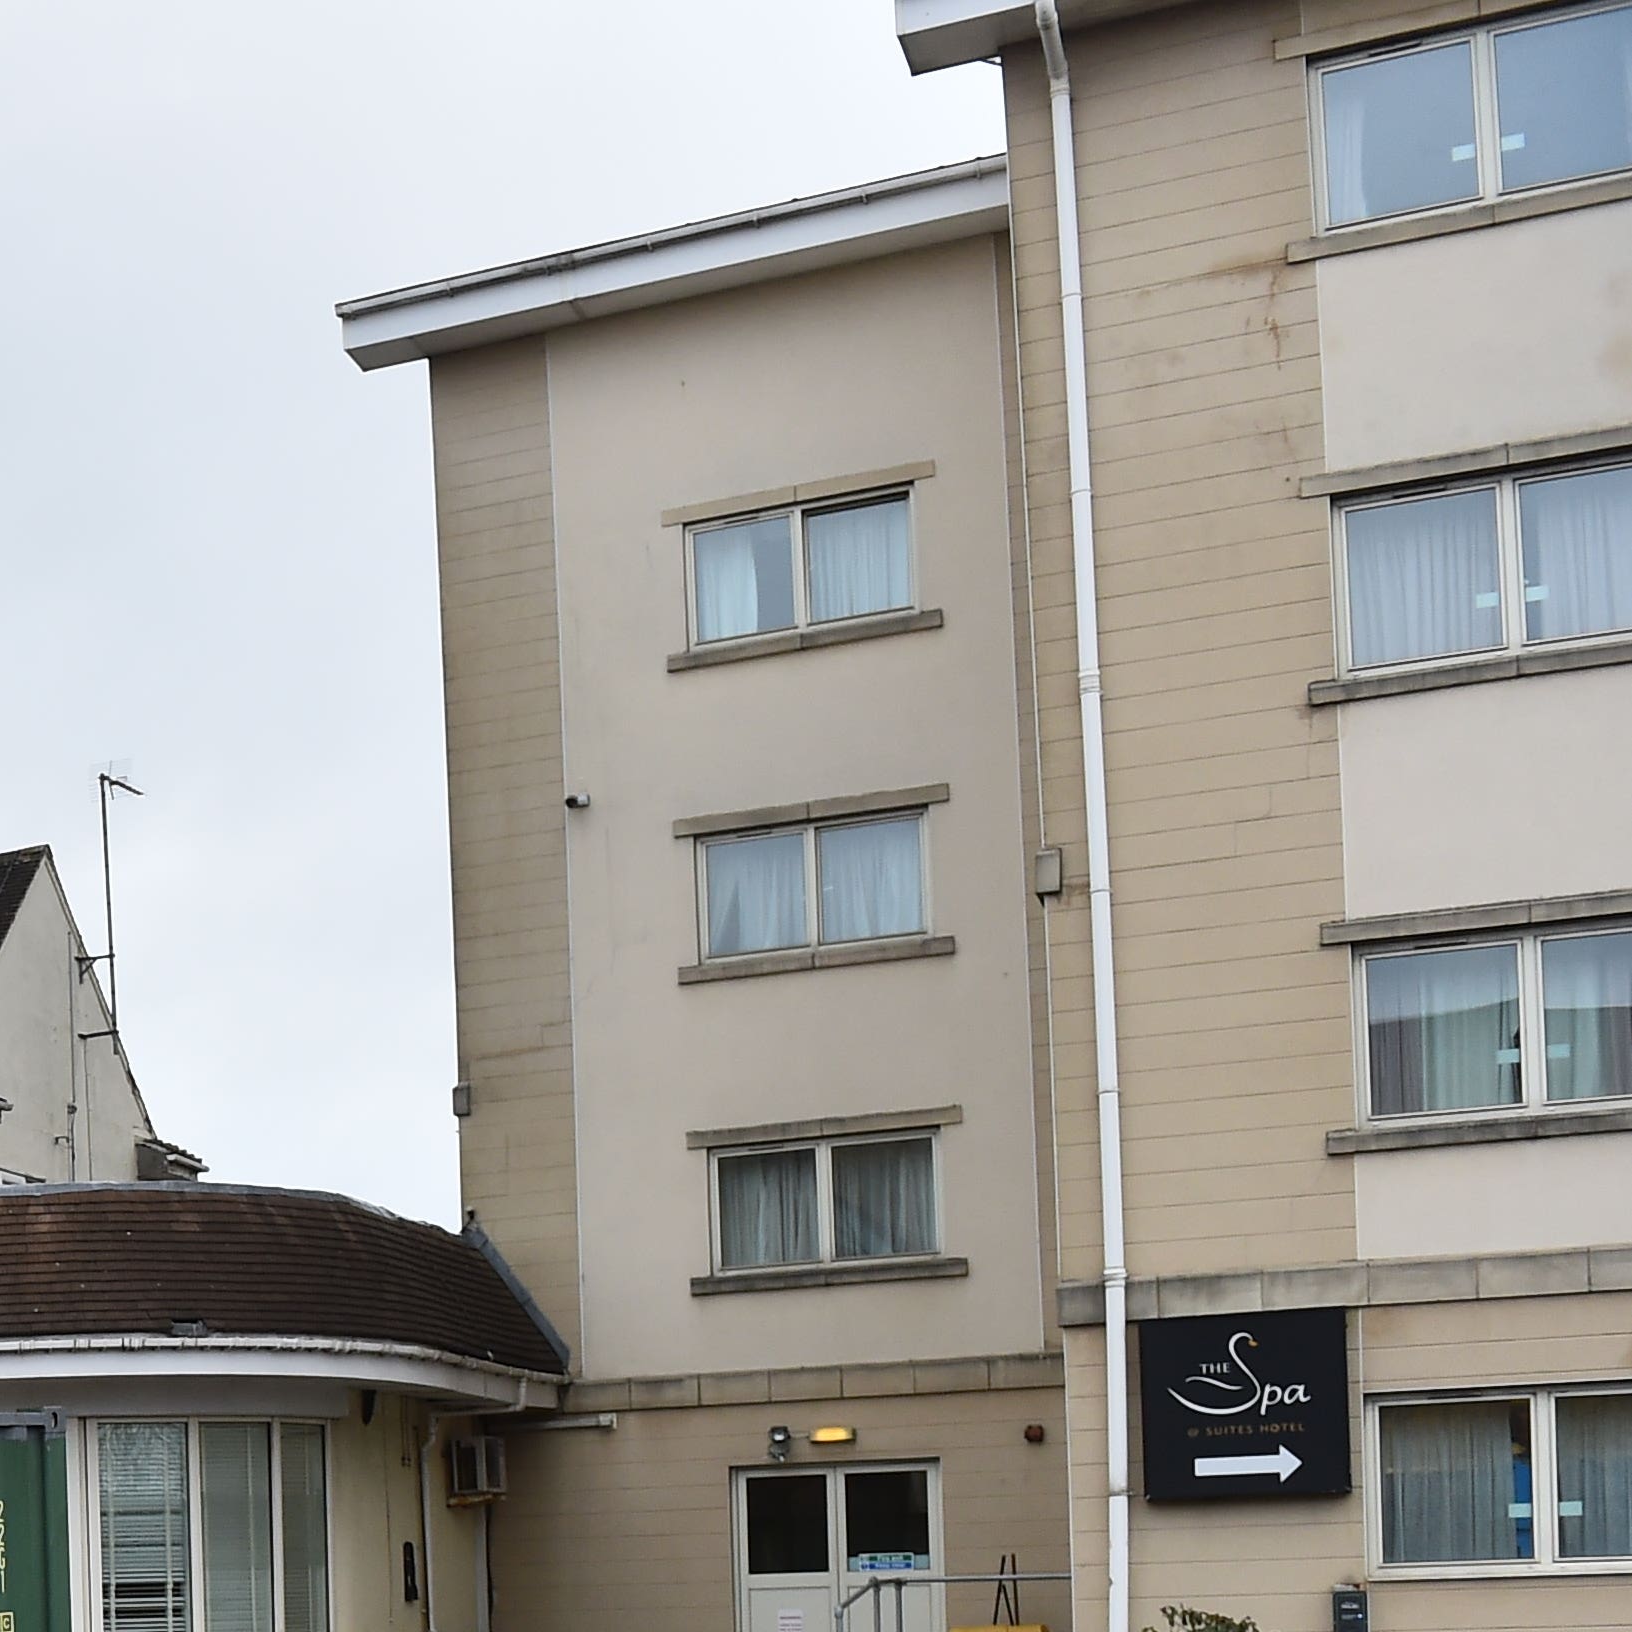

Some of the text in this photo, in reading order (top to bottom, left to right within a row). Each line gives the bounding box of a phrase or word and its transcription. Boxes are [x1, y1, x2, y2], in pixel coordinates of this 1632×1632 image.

[1167, 1331, 1311, 1416] THE Spa
[1205, 1425, 1253, 1436] SUITES
[1260, 1422, 1305, 1433] HOTEL
